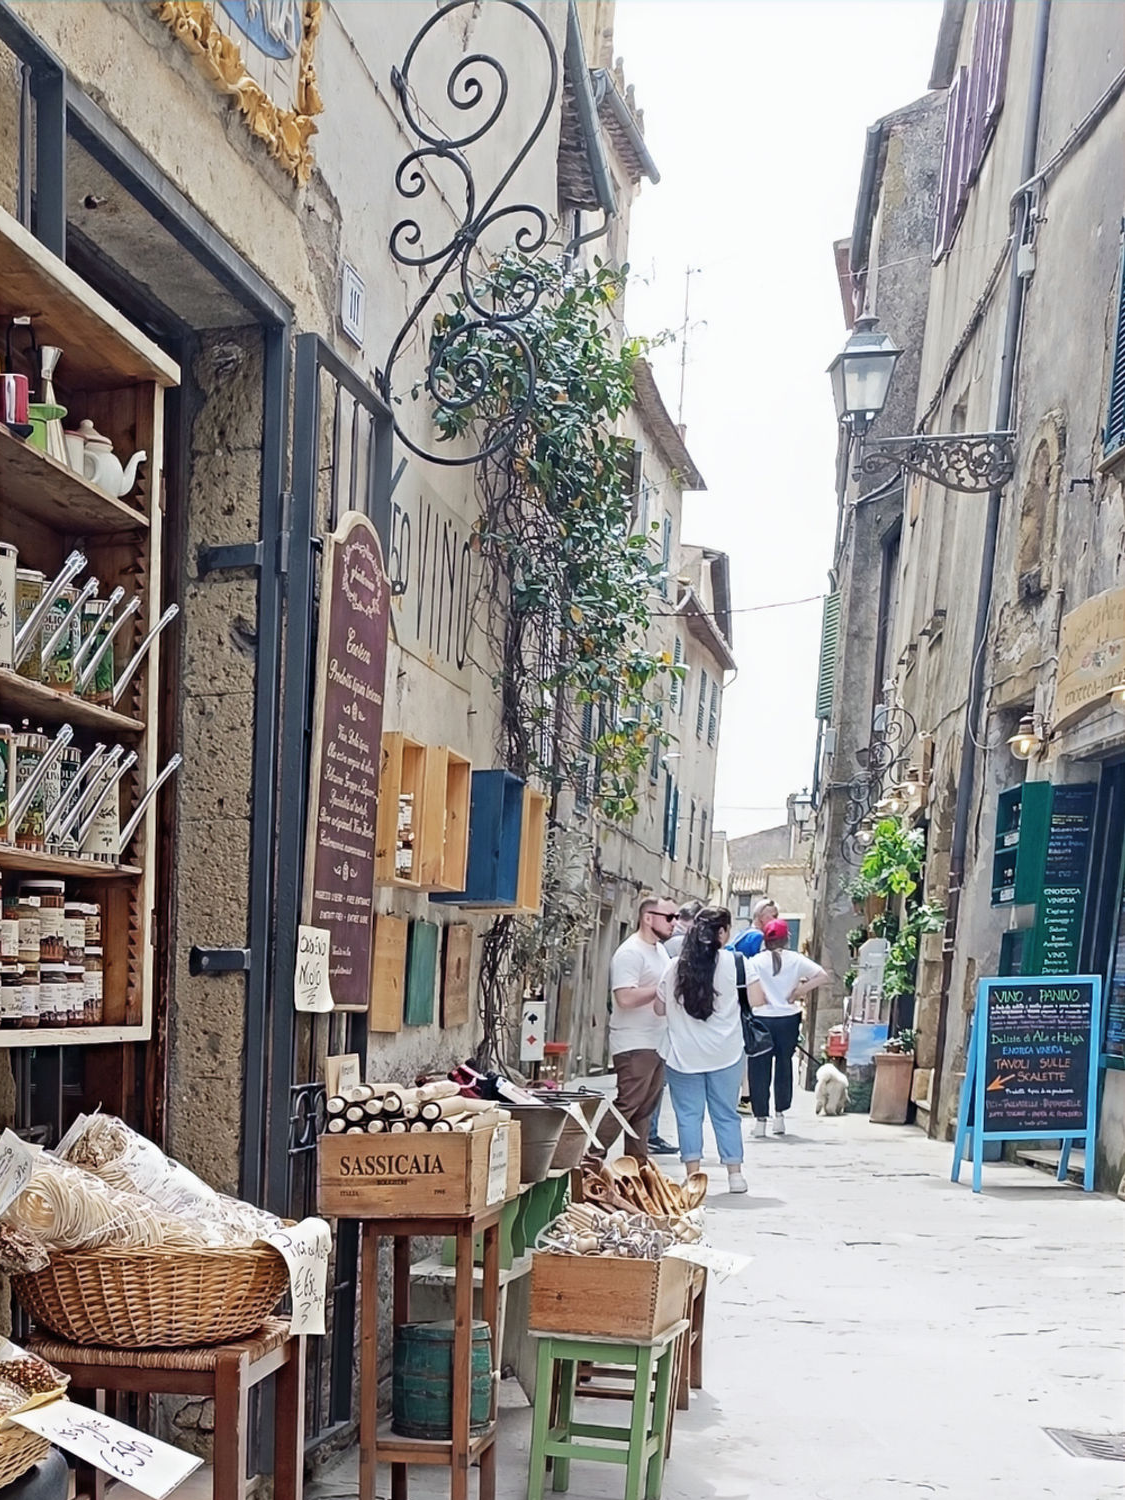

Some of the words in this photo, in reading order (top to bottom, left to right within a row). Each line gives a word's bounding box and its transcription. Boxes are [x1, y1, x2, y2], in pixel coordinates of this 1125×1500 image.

[994, 991, 1023, 1003] VINO
[1039, 989, 1080, 1002] PANINO
[990, 1034, 1021, 1044] Delizie
[1023, 1034, 1031, 1042] di
[1002, 1046, 1033, 1055] ENOTECA
[994, 1058, 1029, 1070] TAVOLI
[1039, 1058, 1071, 1068] SULLE
[1017, 1071, 1066, 1082] SCALETTE
[340, 1154, 445, 1176] SASSICAIA
